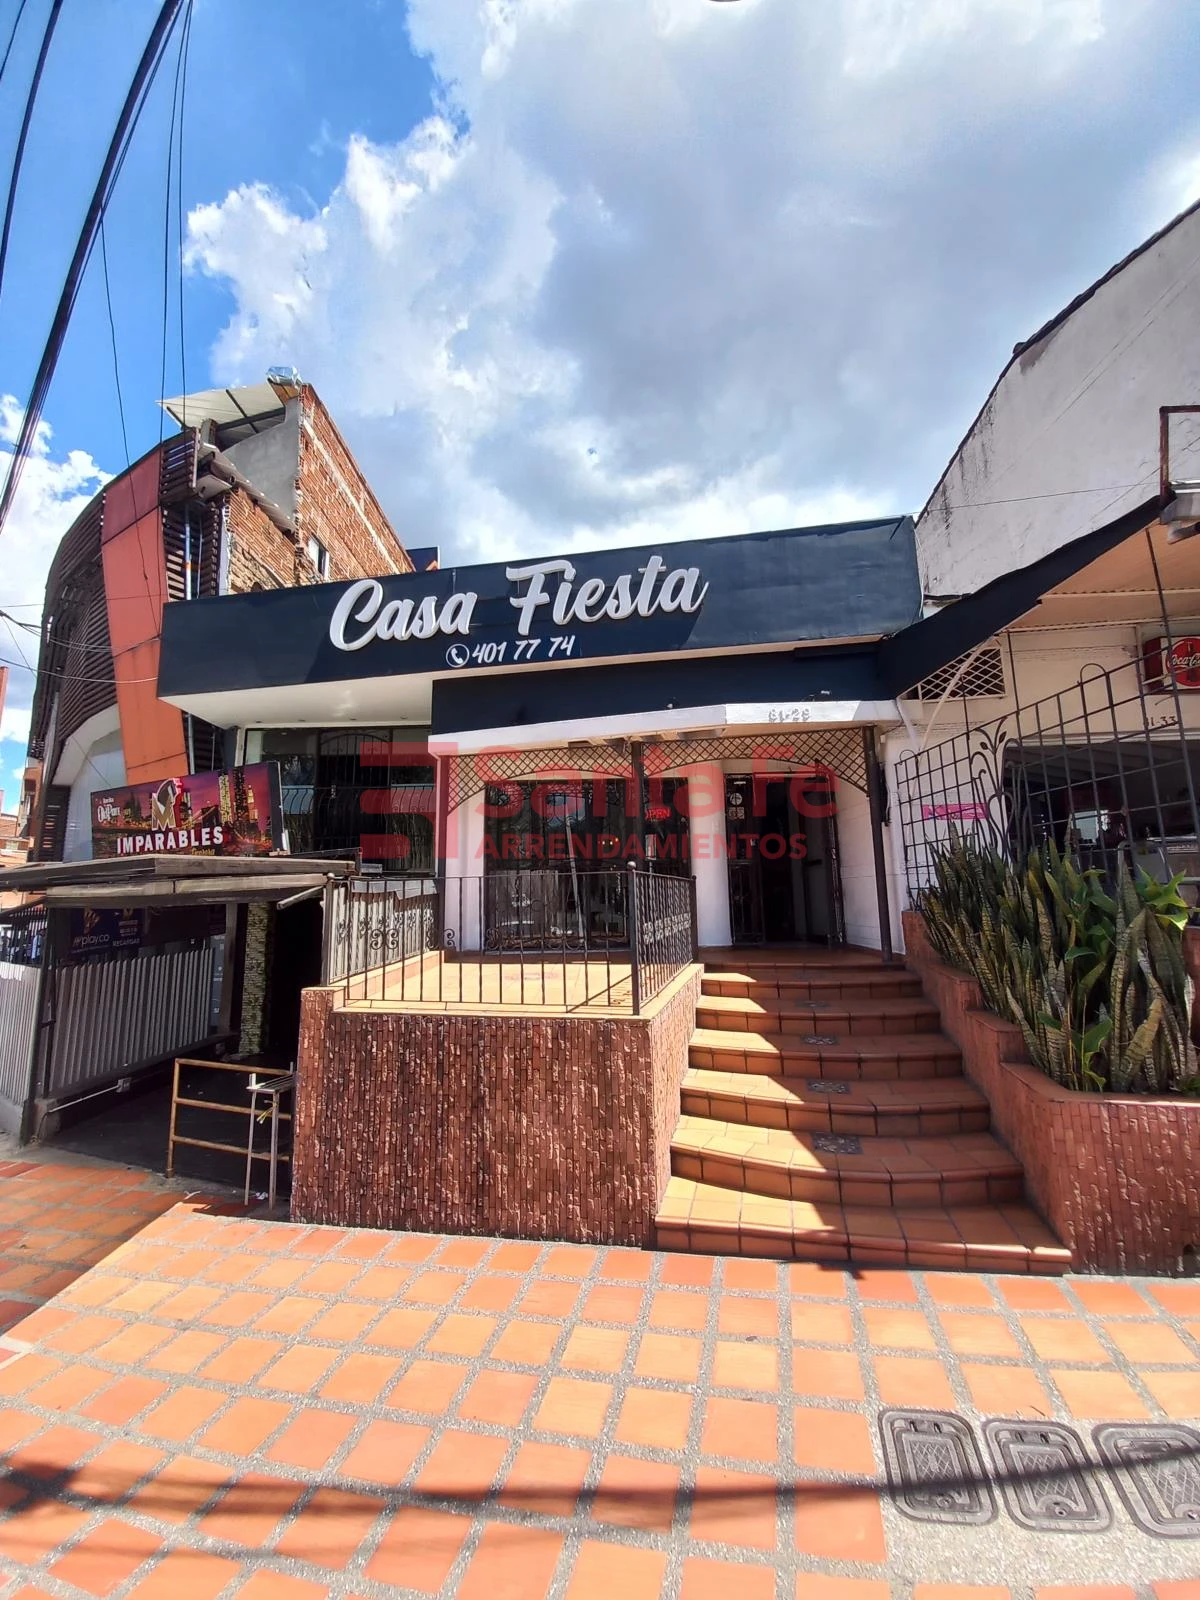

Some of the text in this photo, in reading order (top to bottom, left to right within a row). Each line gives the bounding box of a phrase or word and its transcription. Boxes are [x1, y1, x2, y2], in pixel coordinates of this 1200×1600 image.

[329, 554, 709, 652] Casa Fiesta
[472, 635, 576, 663] 401 77 74
[117, 826, 224, 854] IMPARABLES
